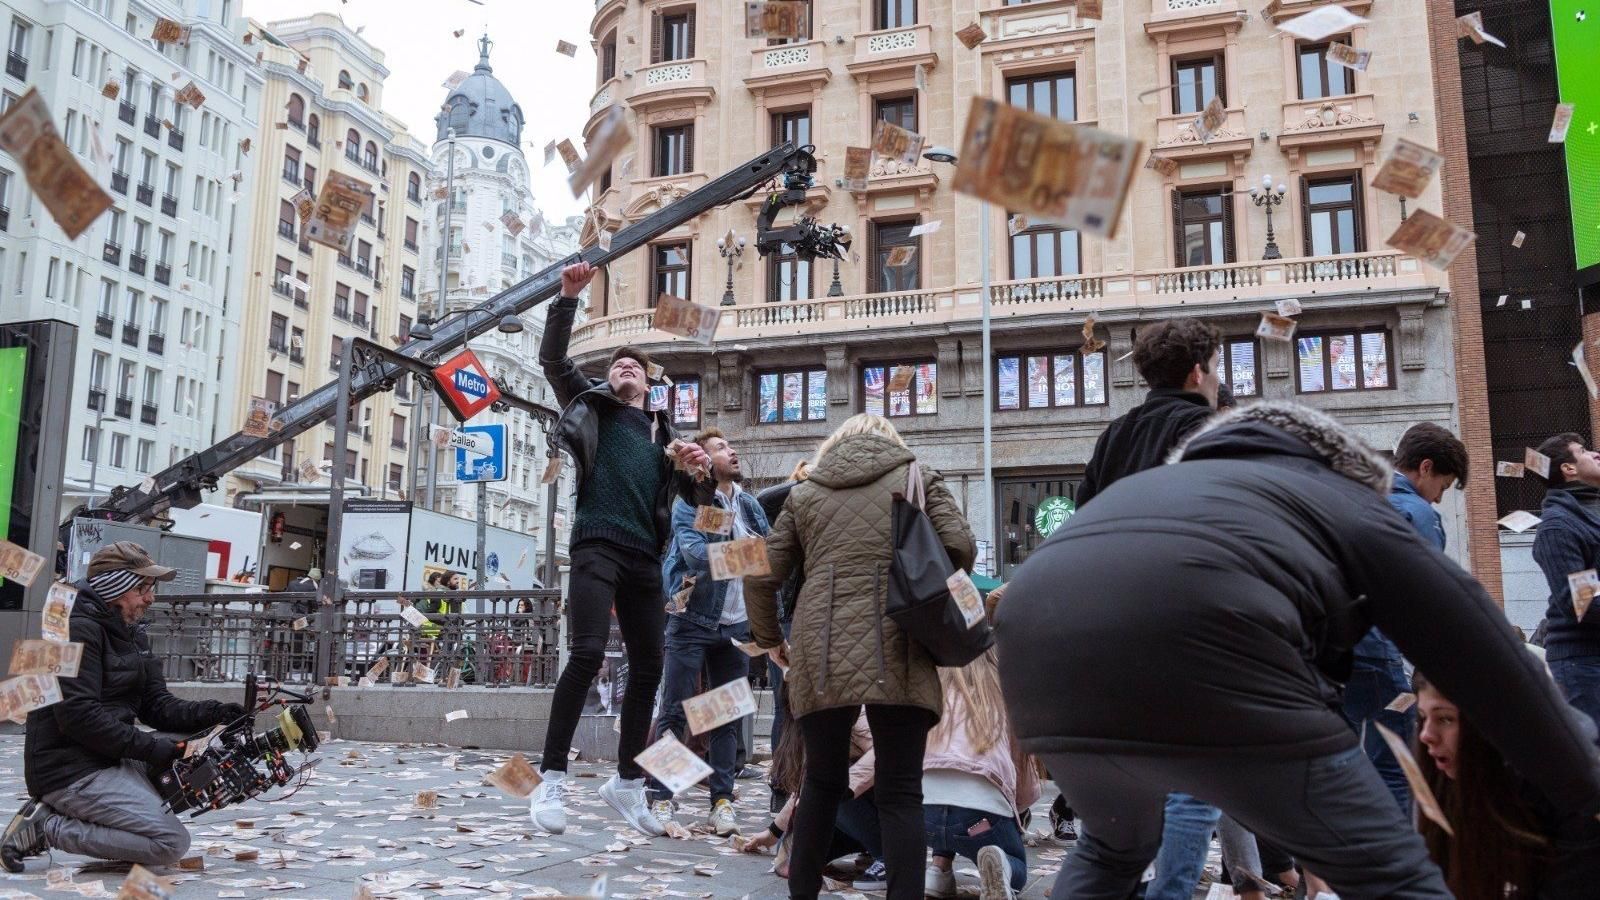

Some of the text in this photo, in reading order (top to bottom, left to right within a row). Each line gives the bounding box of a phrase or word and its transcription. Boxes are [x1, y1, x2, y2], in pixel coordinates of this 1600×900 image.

[458, 372, 486, 394] Metro
[451, 432, 476, 448] Callao
[5, 568, 20, 579] 50
[47, 664, 62, 674] 50
[32, 696, 46, 707] 50
[726, 706, 741, 718] 50
